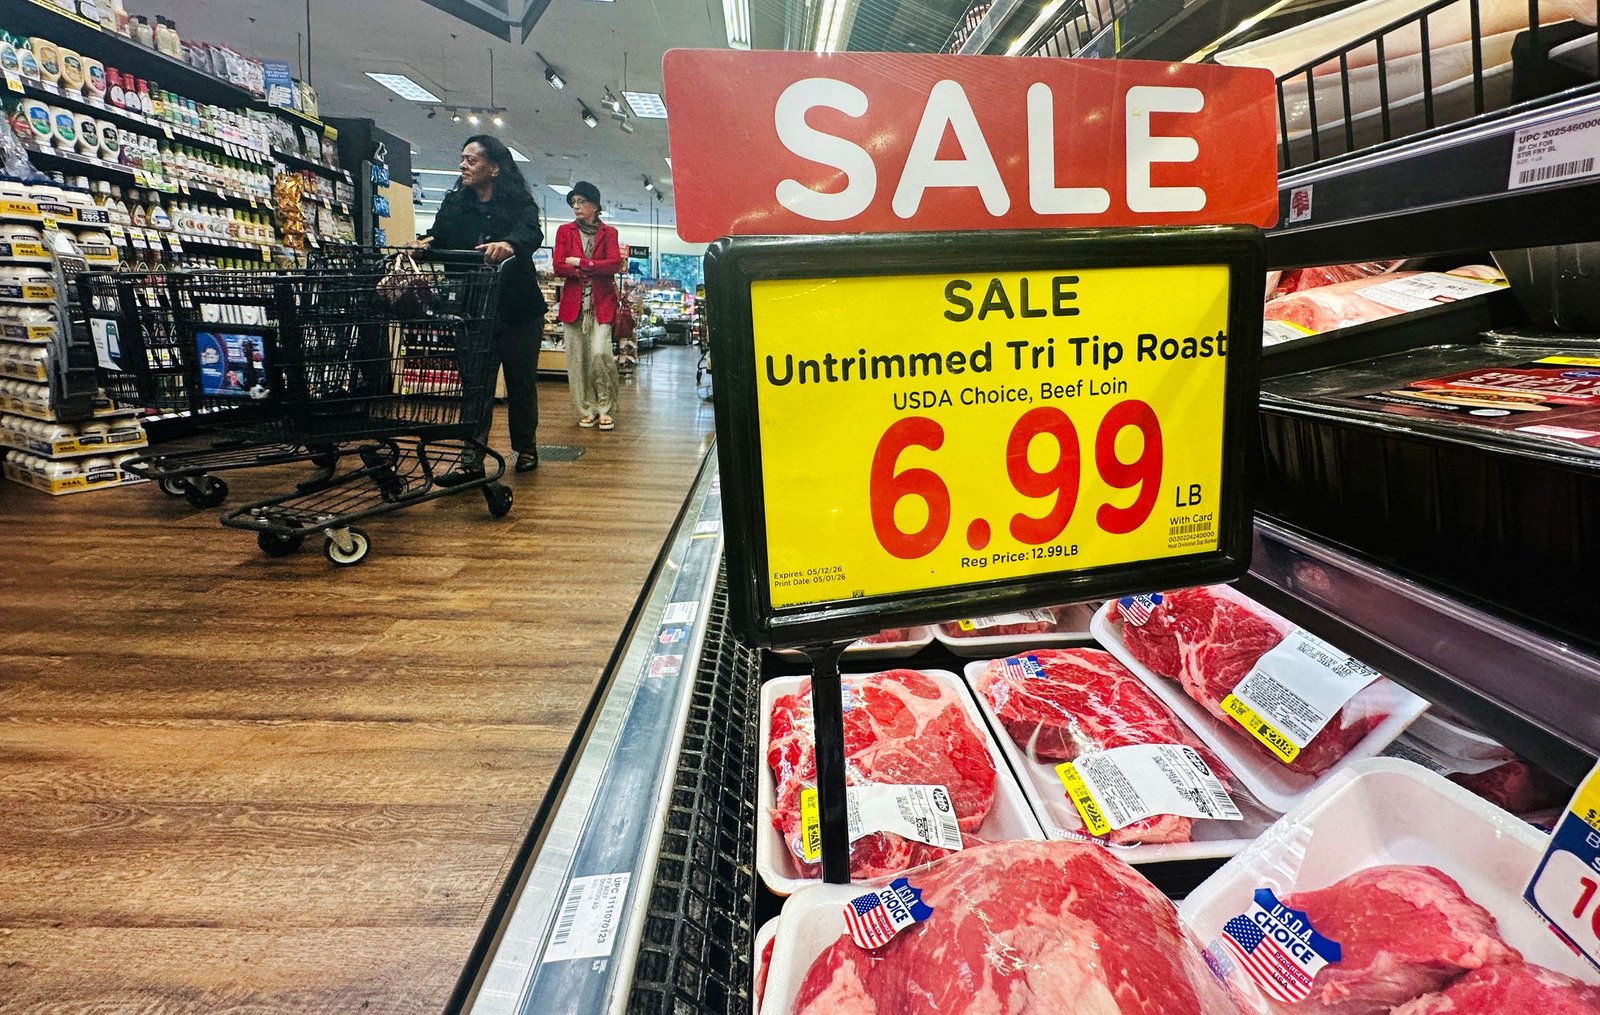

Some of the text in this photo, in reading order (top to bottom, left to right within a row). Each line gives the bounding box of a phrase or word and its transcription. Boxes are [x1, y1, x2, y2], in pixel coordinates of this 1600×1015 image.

[775, 78, 1206, 221] SALE
[1519, 132, 1540, 143] UPC
[1517, 150, 1531, 159] STIR
[943, 275, 1080, 322] SALE
[765, 329, 1228, 387] Untrimmed Tri Tip Roast
[893, 376, 1128, 411] USDA Choice, Beef Loin
[869, 399, 1163, 560] 6.99
[1175, 484, 1202, 507] LB
[1169, 512, 1213, 526] With Card
[961, 557, 987, 568] Reg
[992, 551, 1029, 564] Price:
[774, 566, 842, 580] Expires: 05/12/26
[774, 573, 846, 588] Print Date: 05/01/26
[611, 877, 621, 894] UPC
[896, 885, 919, 910] U.S.D.A.
[879, 890, 909, 924] CHOICE
[597, 896, 617, 944] 1111070123
[1270, 903, 1314, 945] U.S.D.A.
[1254, 911, 1315, 965] CHOICE
[1271, 971, 1288, 989] USA
[1274, 951, 1312, 986] Produced
[1284, 971, 1297, 985] the
